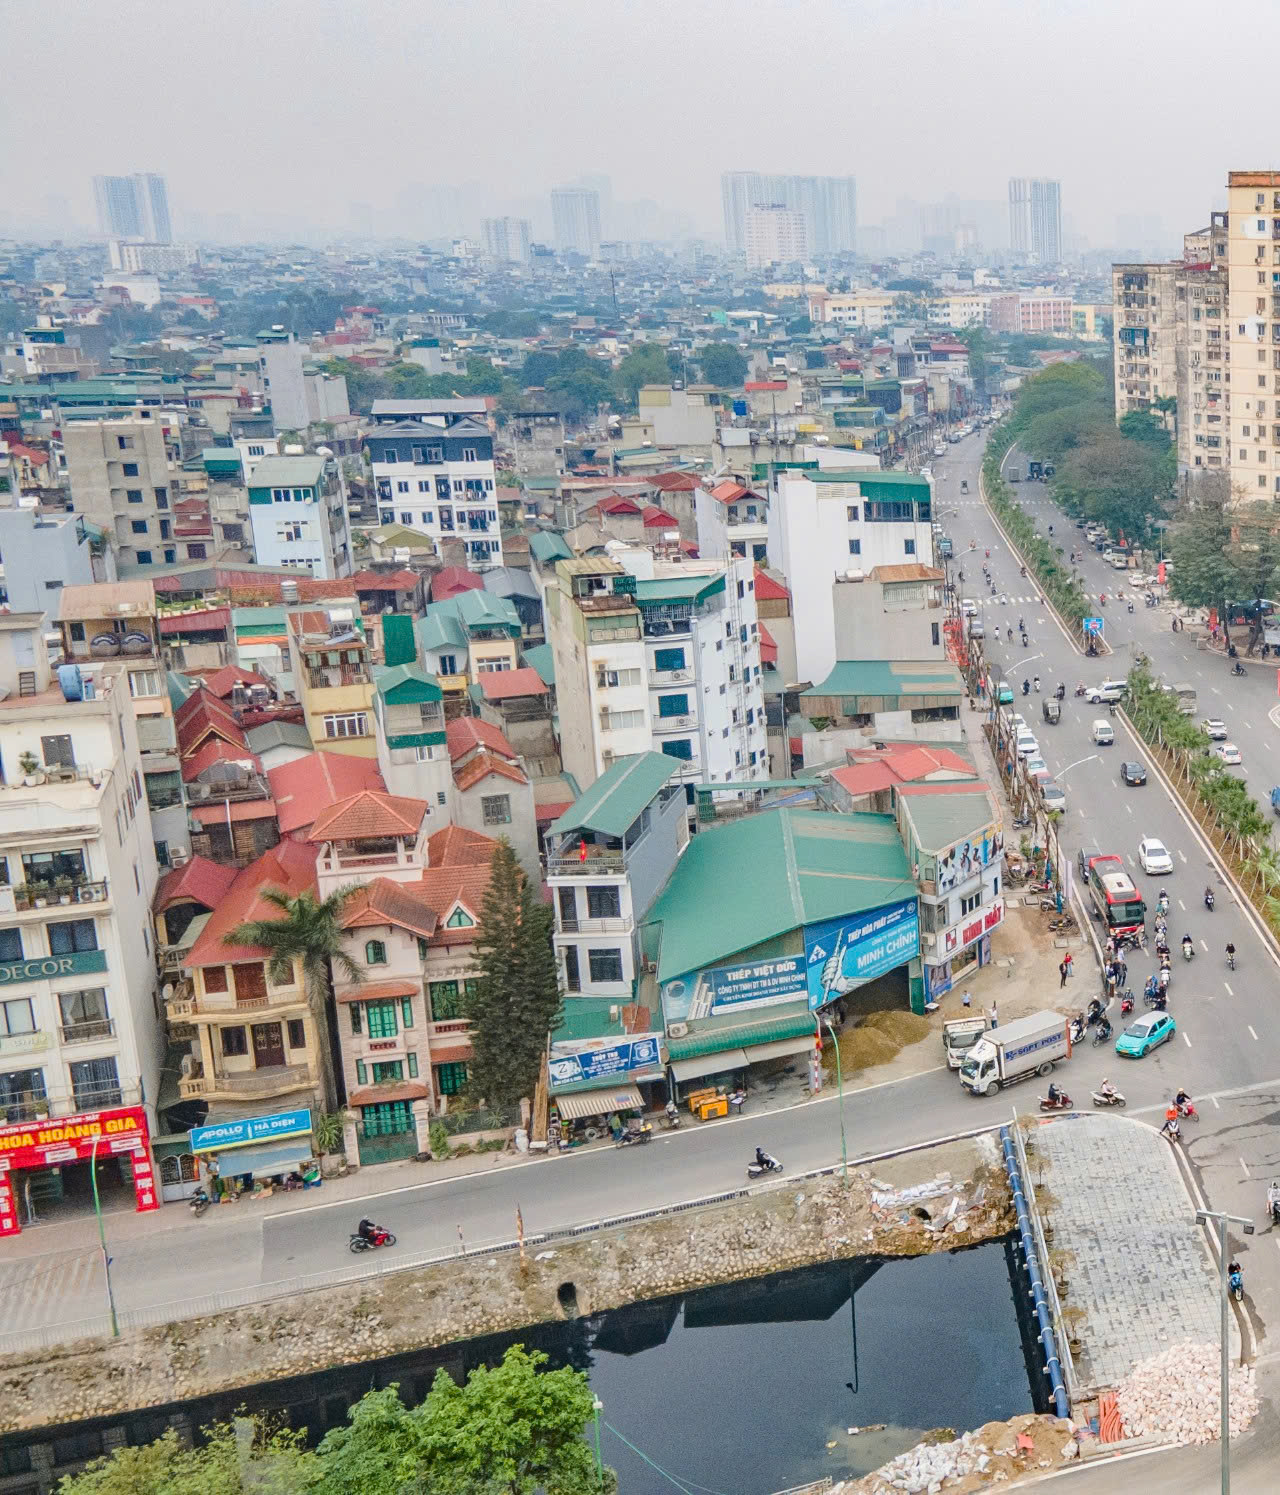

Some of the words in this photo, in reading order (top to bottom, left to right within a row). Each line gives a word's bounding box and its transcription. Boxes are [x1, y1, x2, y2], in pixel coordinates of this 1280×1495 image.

[857, 948, 885, 969] MINH
[885, 929, 916, 954] CHÍNH
[0, 958, 75, 981] DECOR
[727, 968, 752, 981] THÉP
[753, 964, 775, 978] VIỆT
[776, 960, 797, 973] ĐỨC
[718, 983, 733, 995] CÔNG
[1040, 1032, 1063, 1047] POST
[38, 1122, 102, 1143] HOÀNG
[105, 1116, 138, 1133] GIA
[197, 1125, 244, 1142] APOLLO
